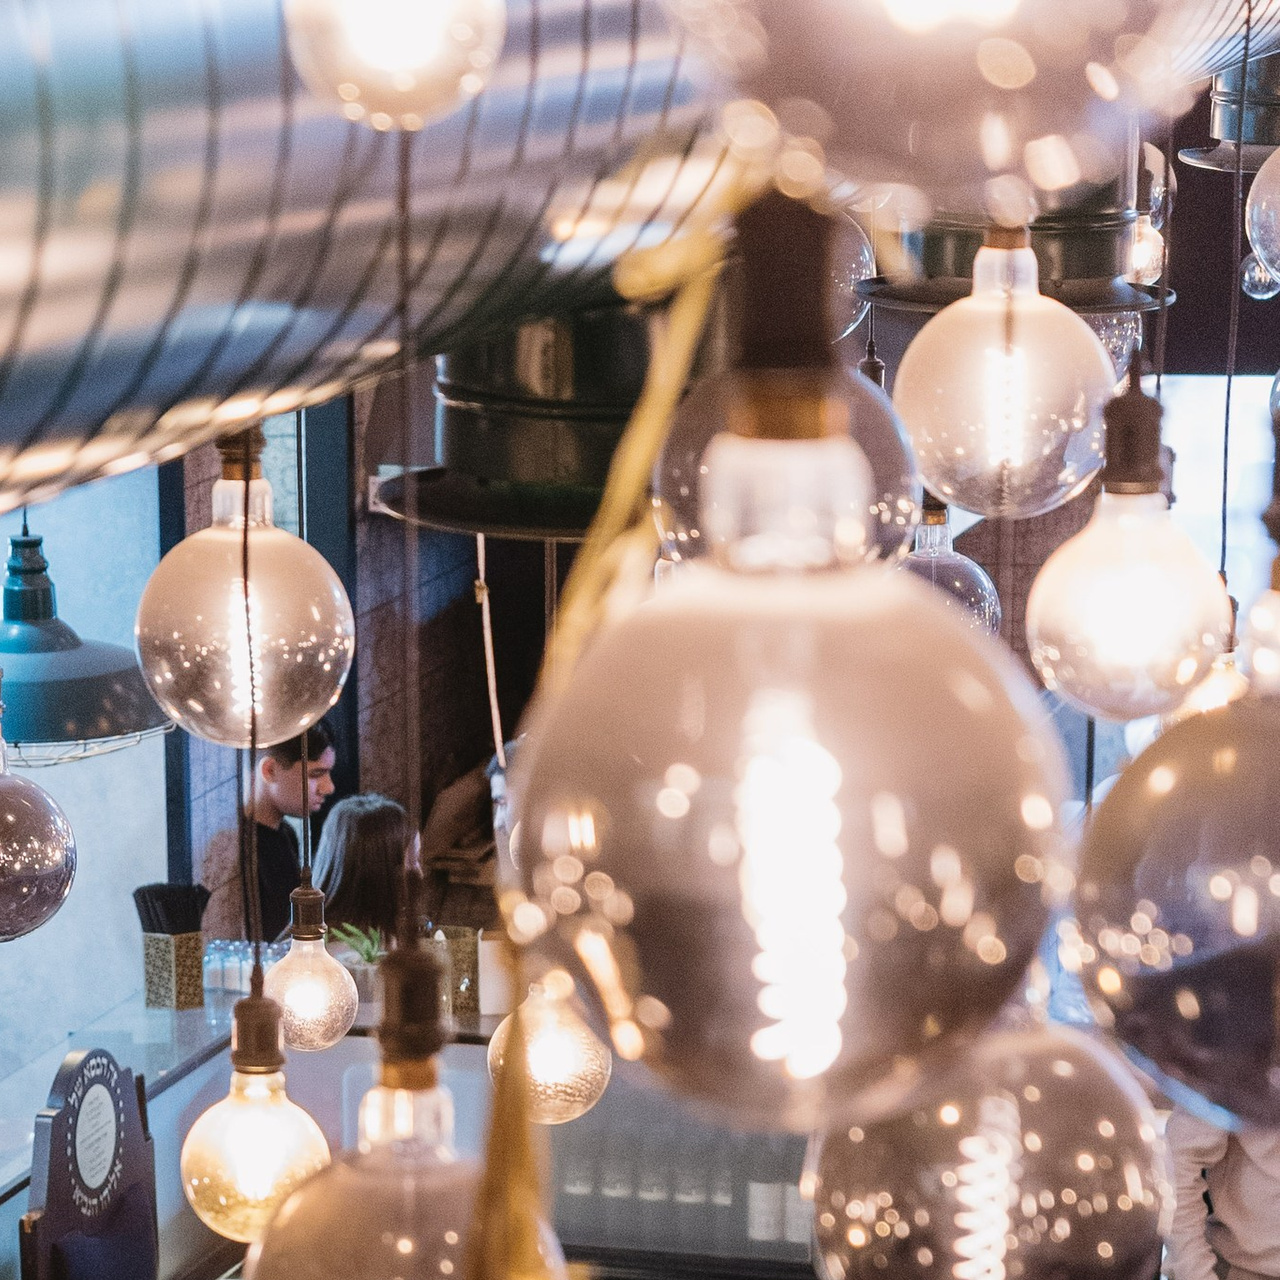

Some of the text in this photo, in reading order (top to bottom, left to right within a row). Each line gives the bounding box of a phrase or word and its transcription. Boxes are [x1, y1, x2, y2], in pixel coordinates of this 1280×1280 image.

[67, 1076, 83, 1109] של
[72, 1158, 122, 1217] אליהו הנביא
